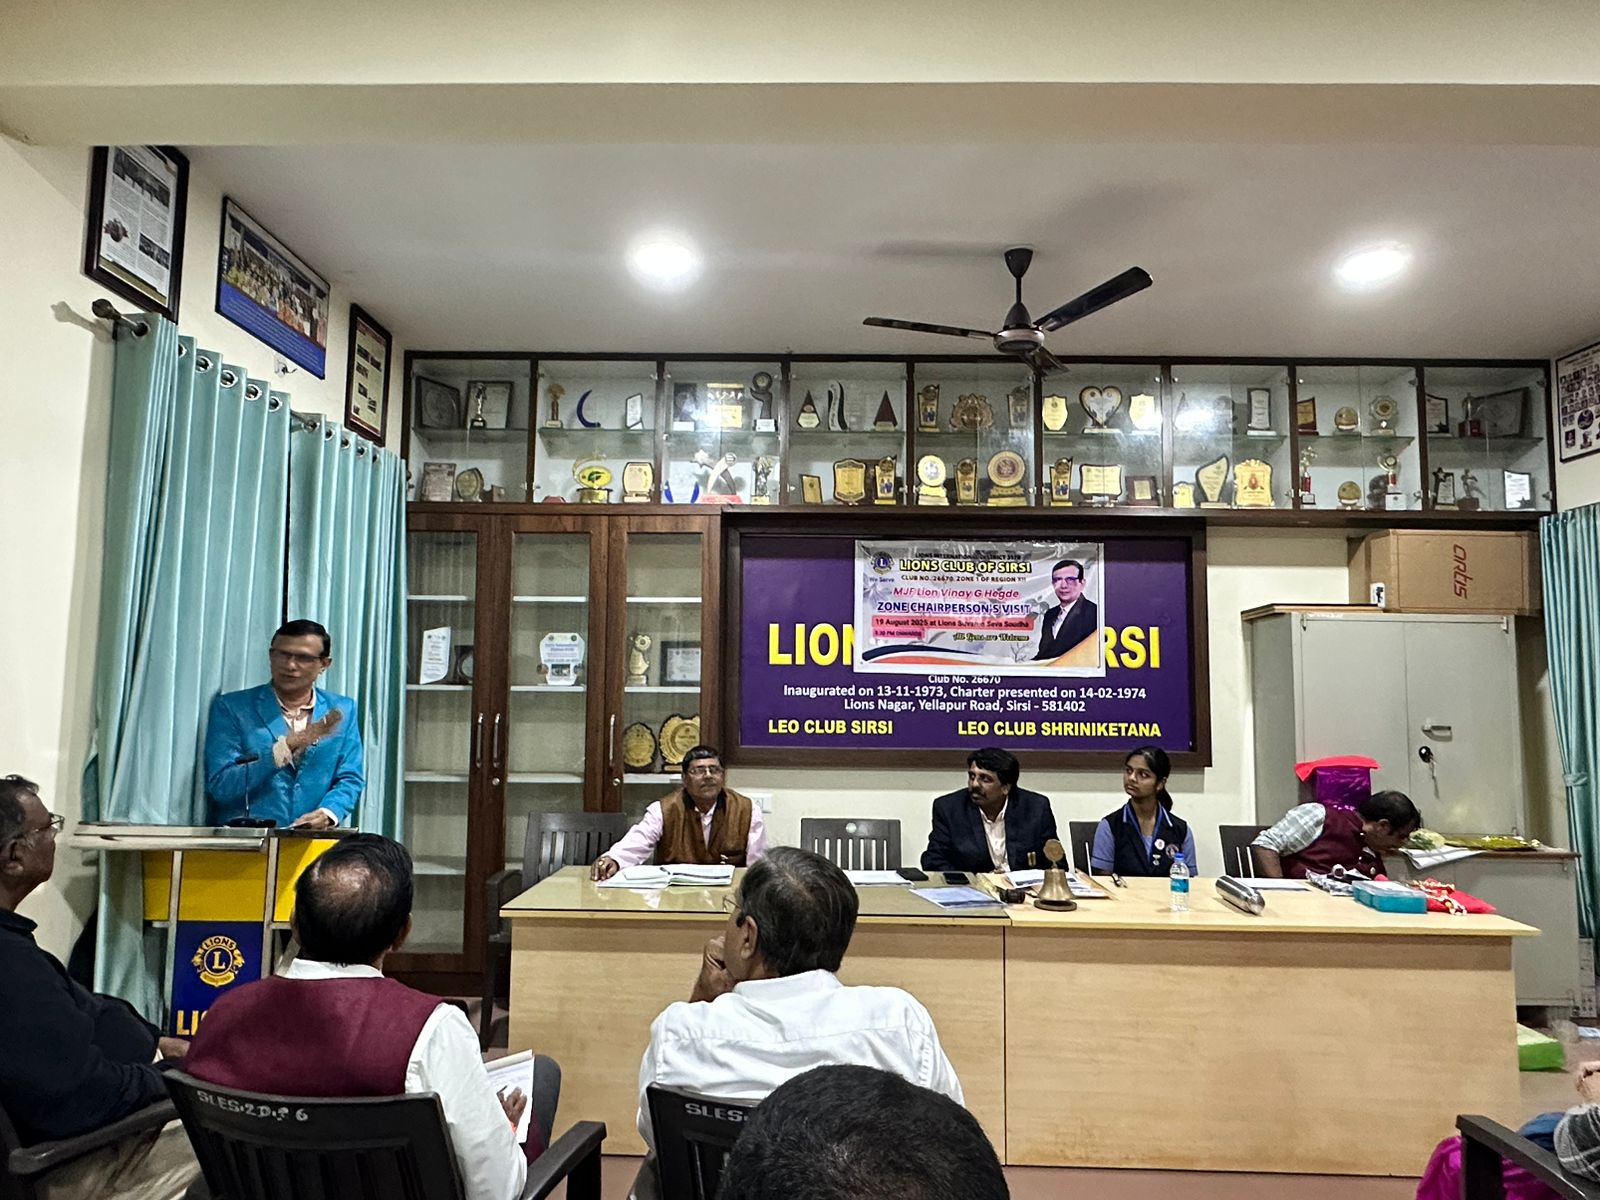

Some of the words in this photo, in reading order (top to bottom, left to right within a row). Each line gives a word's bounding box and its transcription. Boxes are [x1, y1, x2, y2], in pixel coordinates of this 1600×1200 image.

[899, 559, 940, 572] LIONS
[941, 560, 975, 573] CLUB
[977, 561, 996, 573] OF
[997, 561, 1032, 573] SIRSI
[893, 587, 916, 596] MJF
[917, 588, 938, 597] Lion
[940, 589, 972, 598] Vinay
[974, 589, 983, 598] G
[984, 589, 1020, 600] Hegde
[877, 601, 909, 612] ZONE
[910, 602, 999, 614] CHAIRPERSON'S
[1001, 604, 1031, 614] VISIT
[875, 618, 885, 626] 19
[885, 618, 910, 627] August
[910, 619, 929, 627] 2025
[928, 674, 950, 684] Club
[952, 675, 969, 684] No.
[783, 685, 856, 700] Inaugurated
[858, 688, 874, 697] on
[877, 686, 947, 699] 13-11-1973,
[950, 686, 995, 698] Charter
[998, 687, 1058, 701] presented
[1060, 689, 1077, 698] on
[1079, 688, 1147, 699] 14-02-1974
[844, 699, 875, 710] Lions
[878, 700, 916, 713] Nagar,
[918, 700, 967, 713] Yellapur
[970, 700, 1004, 712] Road,
[1007, 701, 1031, 712] Sirsi
[1041, 701, 1086, 712] 581402
[768, 719, 800, 734] LEO
[804, 720, 847, 734] CLUB
[851, 720, 893, 734] SIRSI
[957, 721, 990, 735] LEO
[993, 721, 1037, 736] CLUB
[1041, 722, 1162, 737] SHRINIKETANA
[204, 937, 235, 950] LIONS
[212, 951, 226, 969] L
[176, 1010, 208, 1035] LI
